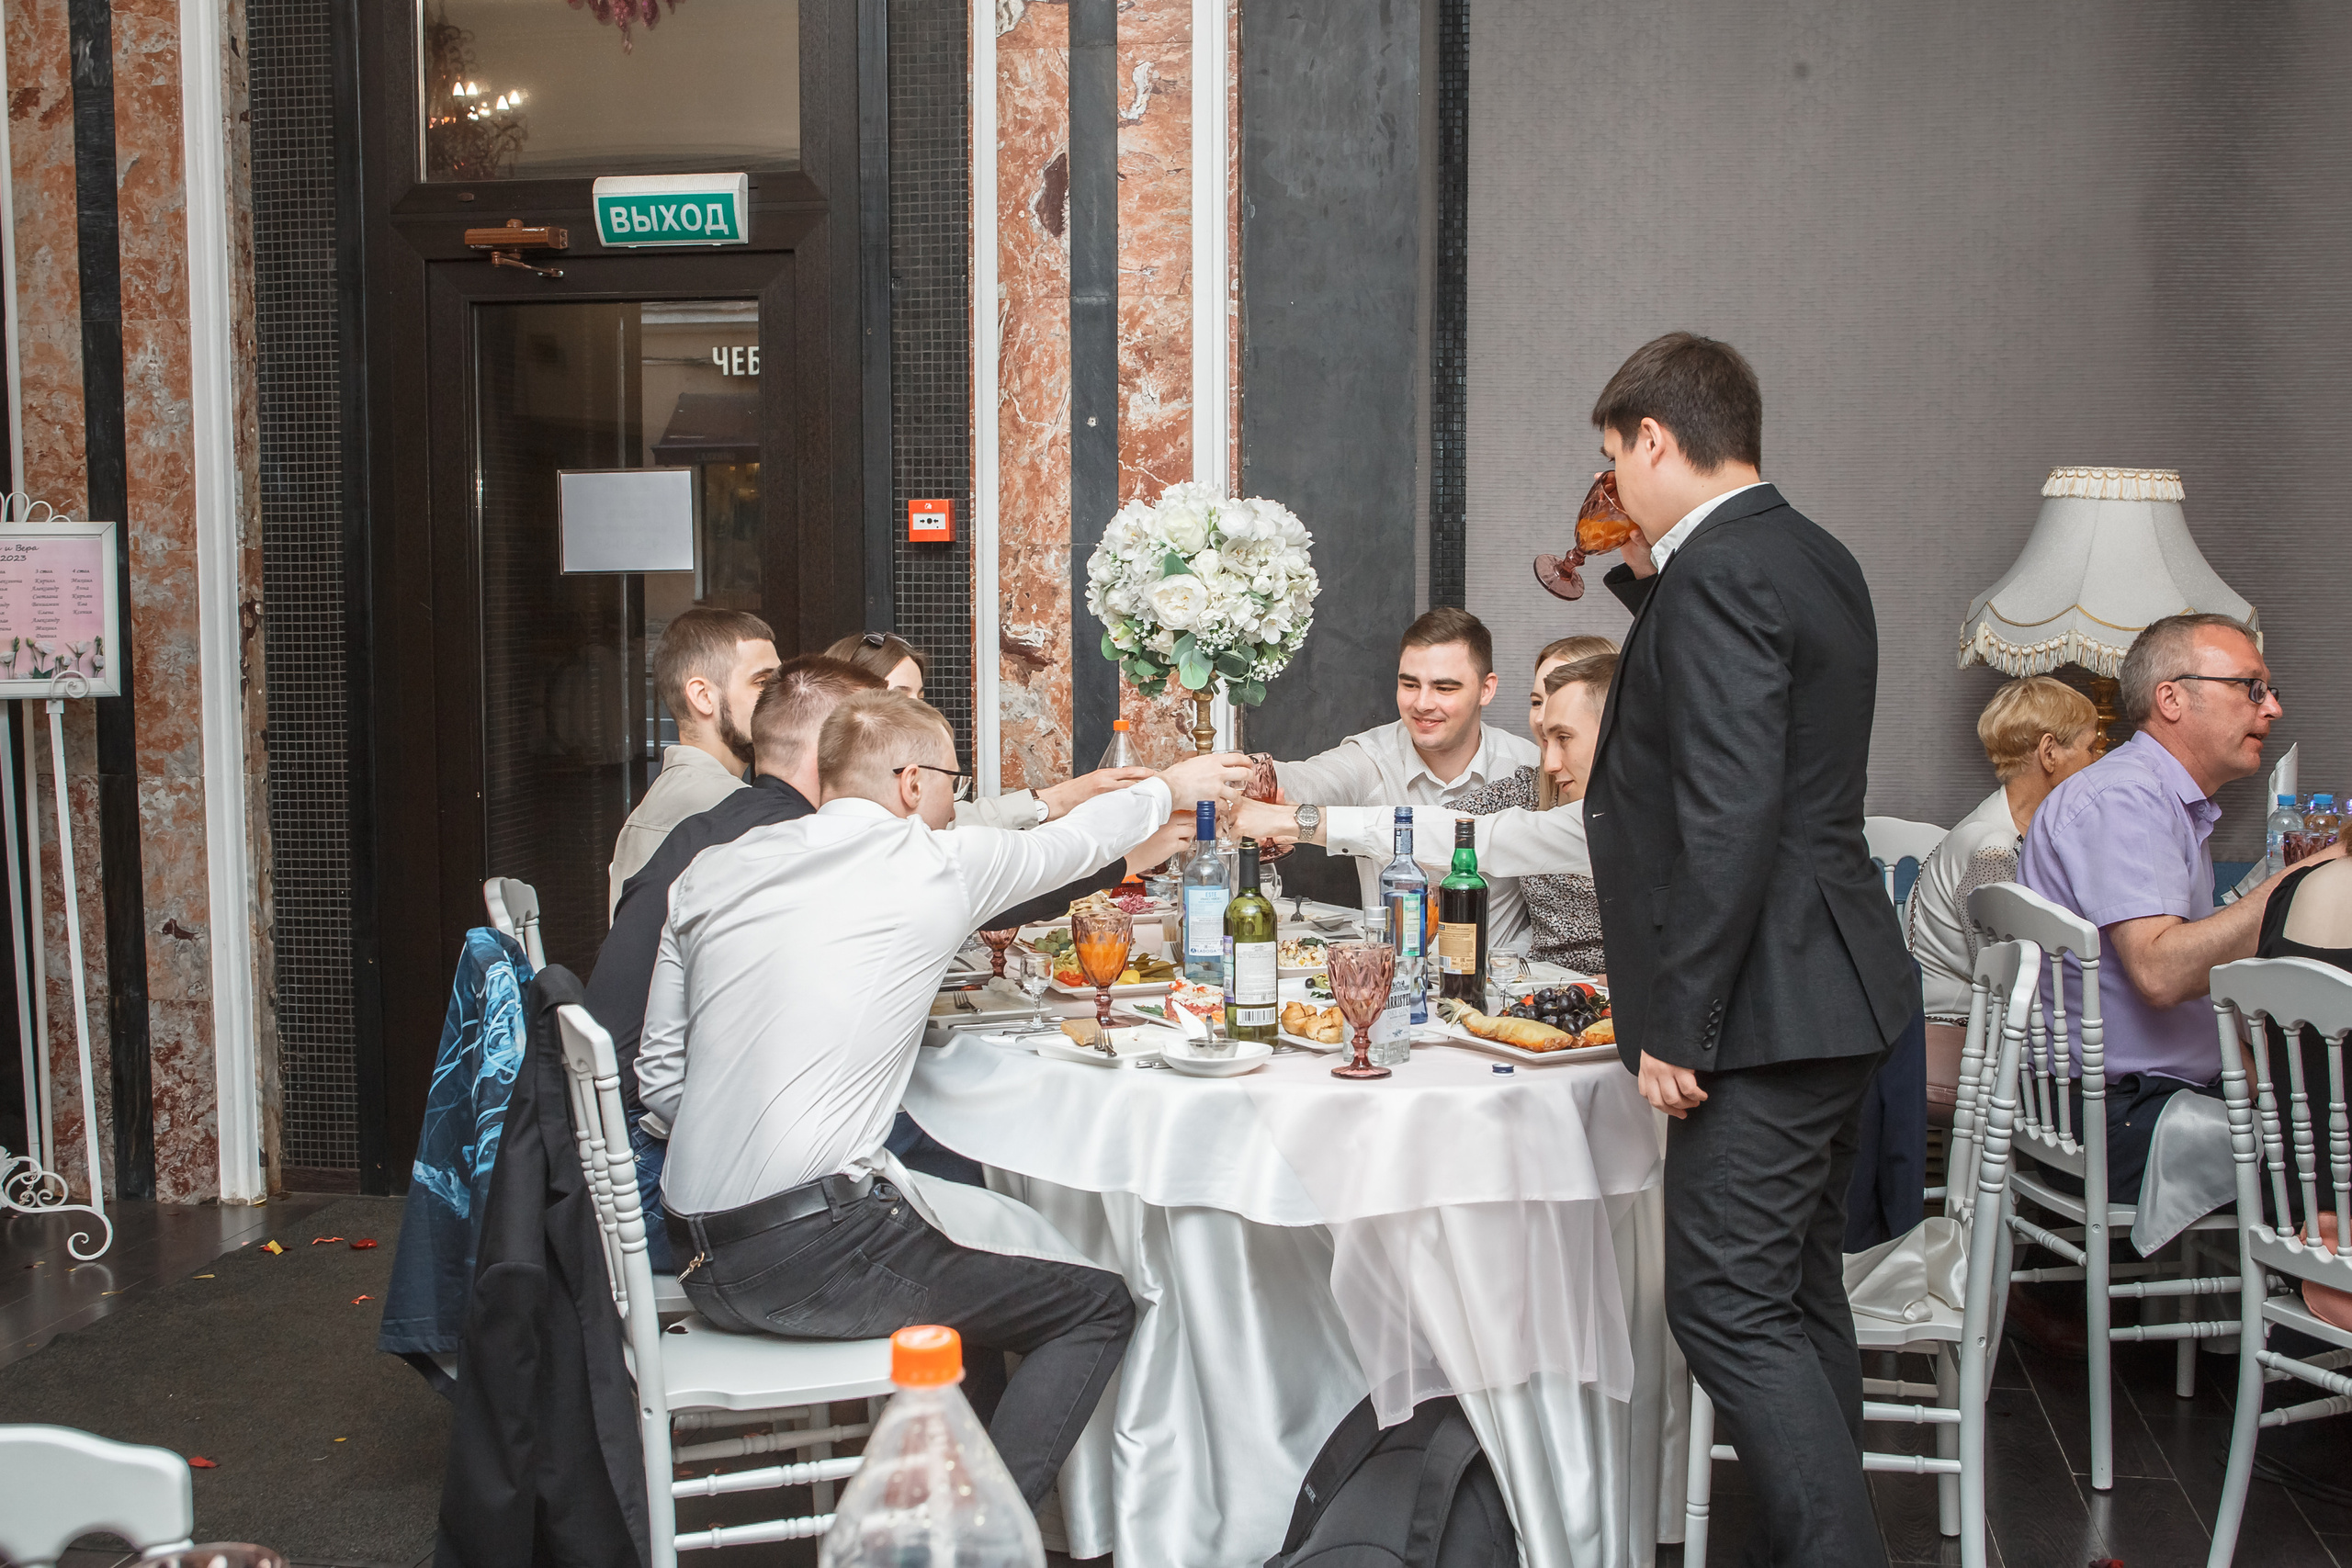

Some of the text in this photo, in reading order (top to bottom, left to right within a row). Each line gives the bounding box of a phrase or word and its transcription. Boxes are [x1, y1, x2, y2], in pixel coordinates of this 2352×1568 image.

[609, 203, 729, 235] ВЫХОД
[712, 345, 760, 376] ЧЕБ
[16, 544, 40, 553] Вера
